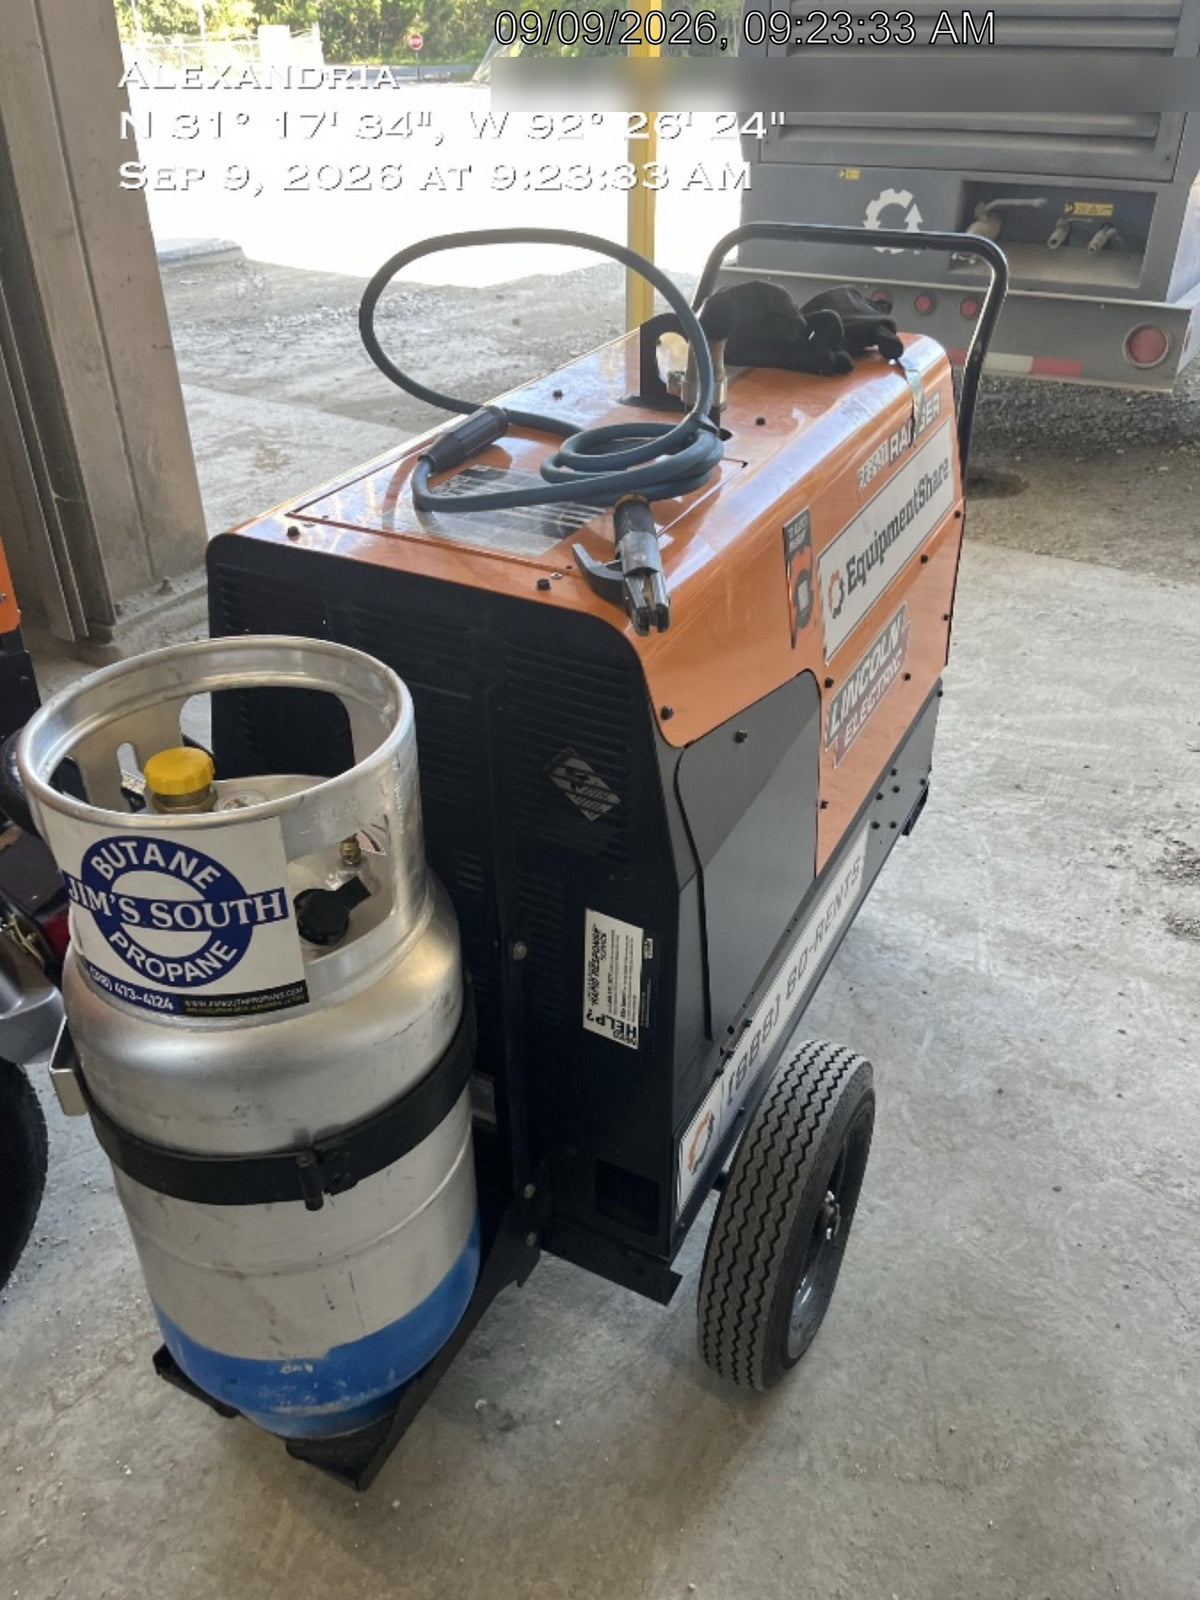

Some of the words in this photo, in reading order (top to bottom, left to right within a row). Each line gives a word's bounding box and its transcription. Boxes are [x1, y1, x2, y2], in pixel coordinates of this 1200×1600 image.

[846, 457, 949, 596] EquipmentShare
[829, 613, 903, 737] LINCOLN
[844, 647, 903, 747] ELECTRIC
[68, 875, 141, 924] JIM'S
[150, 892, 285, 929] SOUTH
[90, 840, 222, 890] BUTANE
[109, 931, 238, 983] PROPANE
[785, 856, 862, 1001] 80-RENTS
